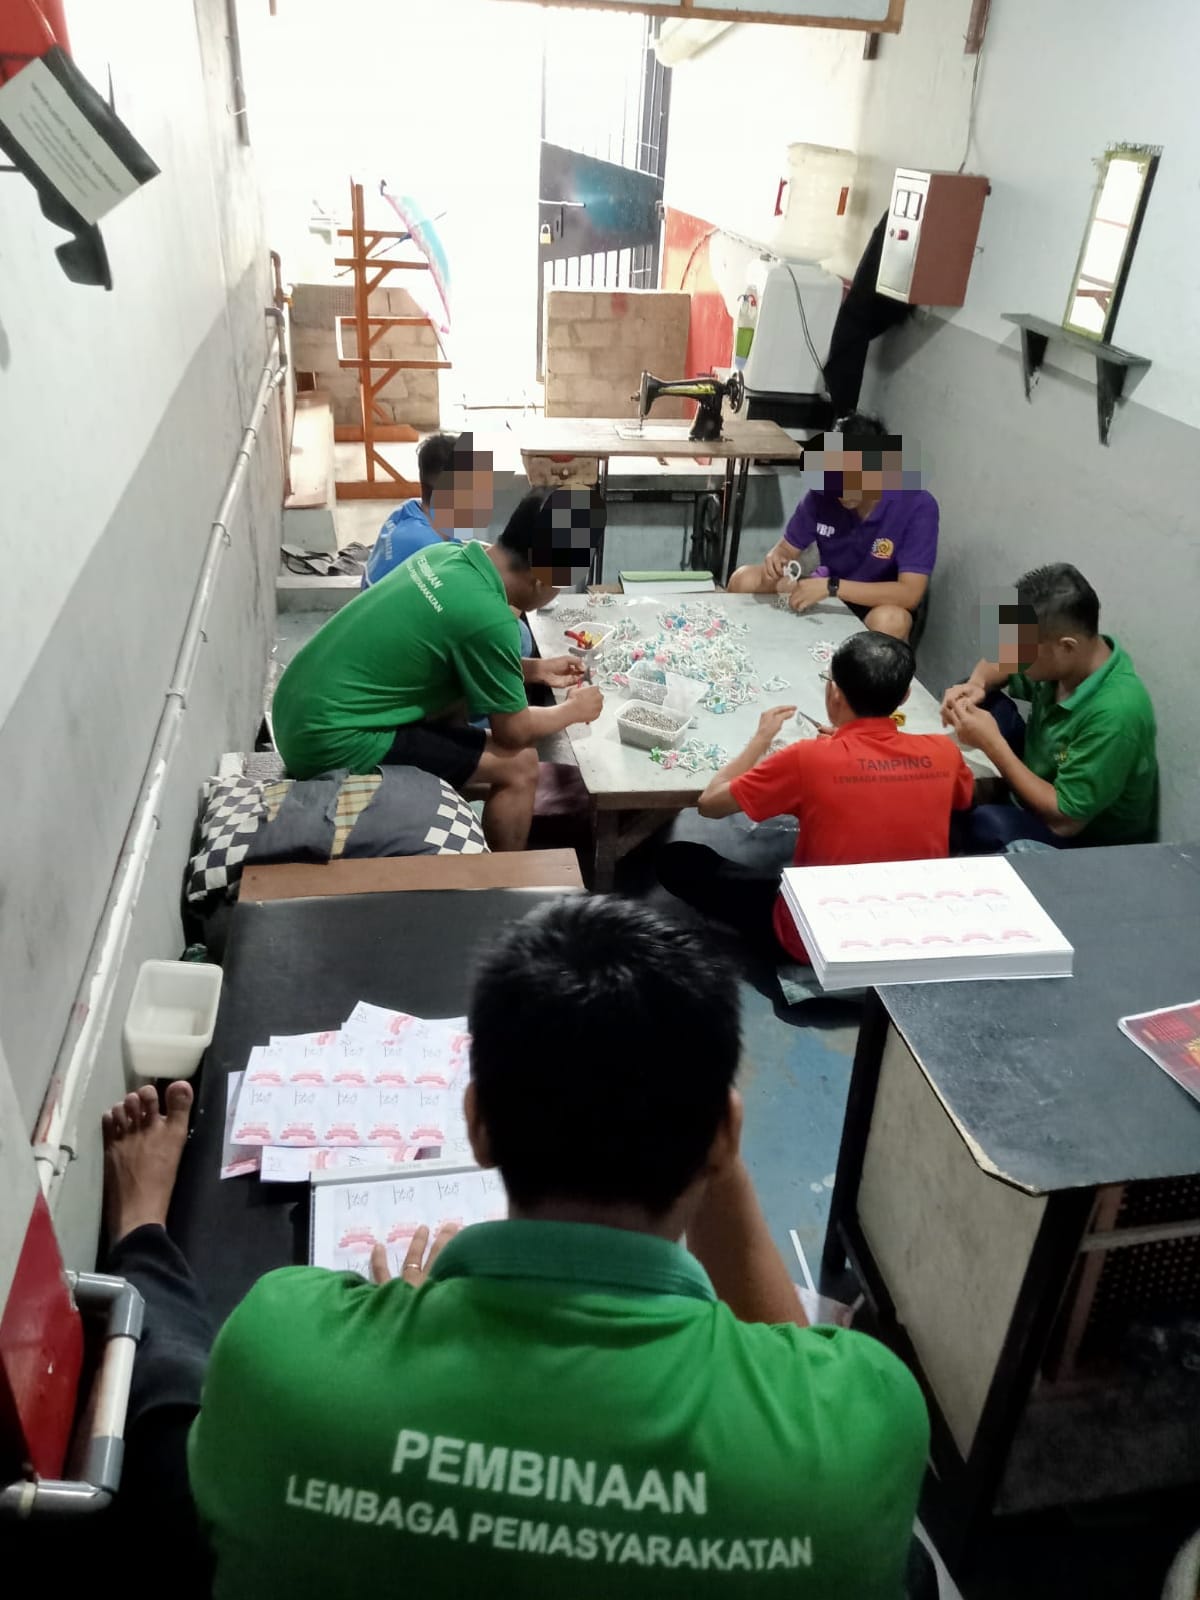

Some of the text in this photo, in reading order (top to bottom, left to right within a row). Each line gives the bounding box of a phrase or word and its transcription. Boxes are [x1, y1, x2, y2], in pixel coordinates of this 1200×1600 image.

[858, 756, 933, 772] TAMPING
[391, 1429, 708, 1514] PEMBINAAN
[285, 1474, 813, 1571] LEMBAGA PEMASYARAKATAN
